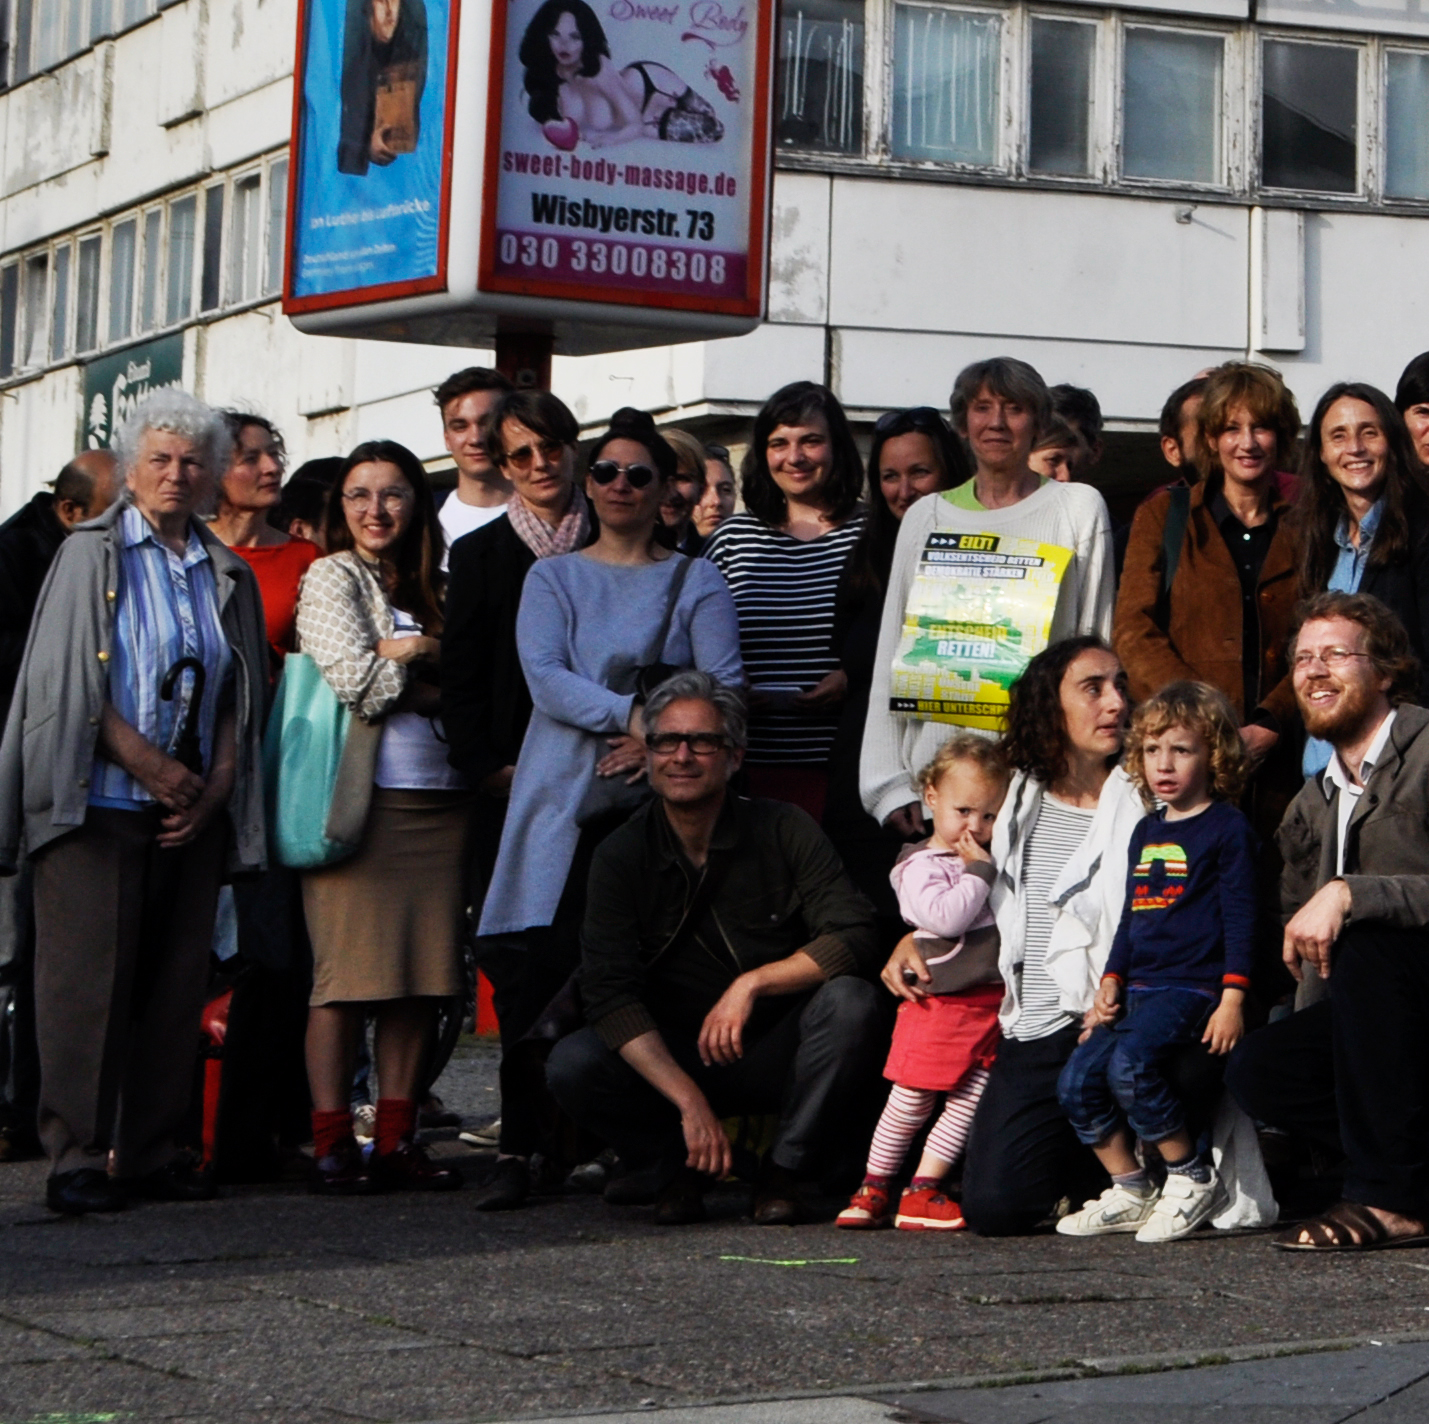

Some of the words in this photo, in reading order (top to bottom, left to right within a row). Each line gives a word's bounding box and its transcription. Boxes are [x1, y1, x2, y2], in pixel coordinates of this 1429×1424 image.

[686, 0, 748, 47] Body
[502, 150, 738, 198] sweet-body-massage.de
[531, 191, 681, 238] Wisbyerstr.
[686, 208, 716, 242] 73
[501, 232, 559, 269] 030
[571, 239, 727, 285] 33008308
[927, 551, 1006, 565] VOLKSENTSCHEID
[1007, 556, 1043, 567] RETTEN
[958, 535, 996, 551] EILT!
[936, 640, 996, 659] RETTEN!
[917, 700, 942, 713] HIER
